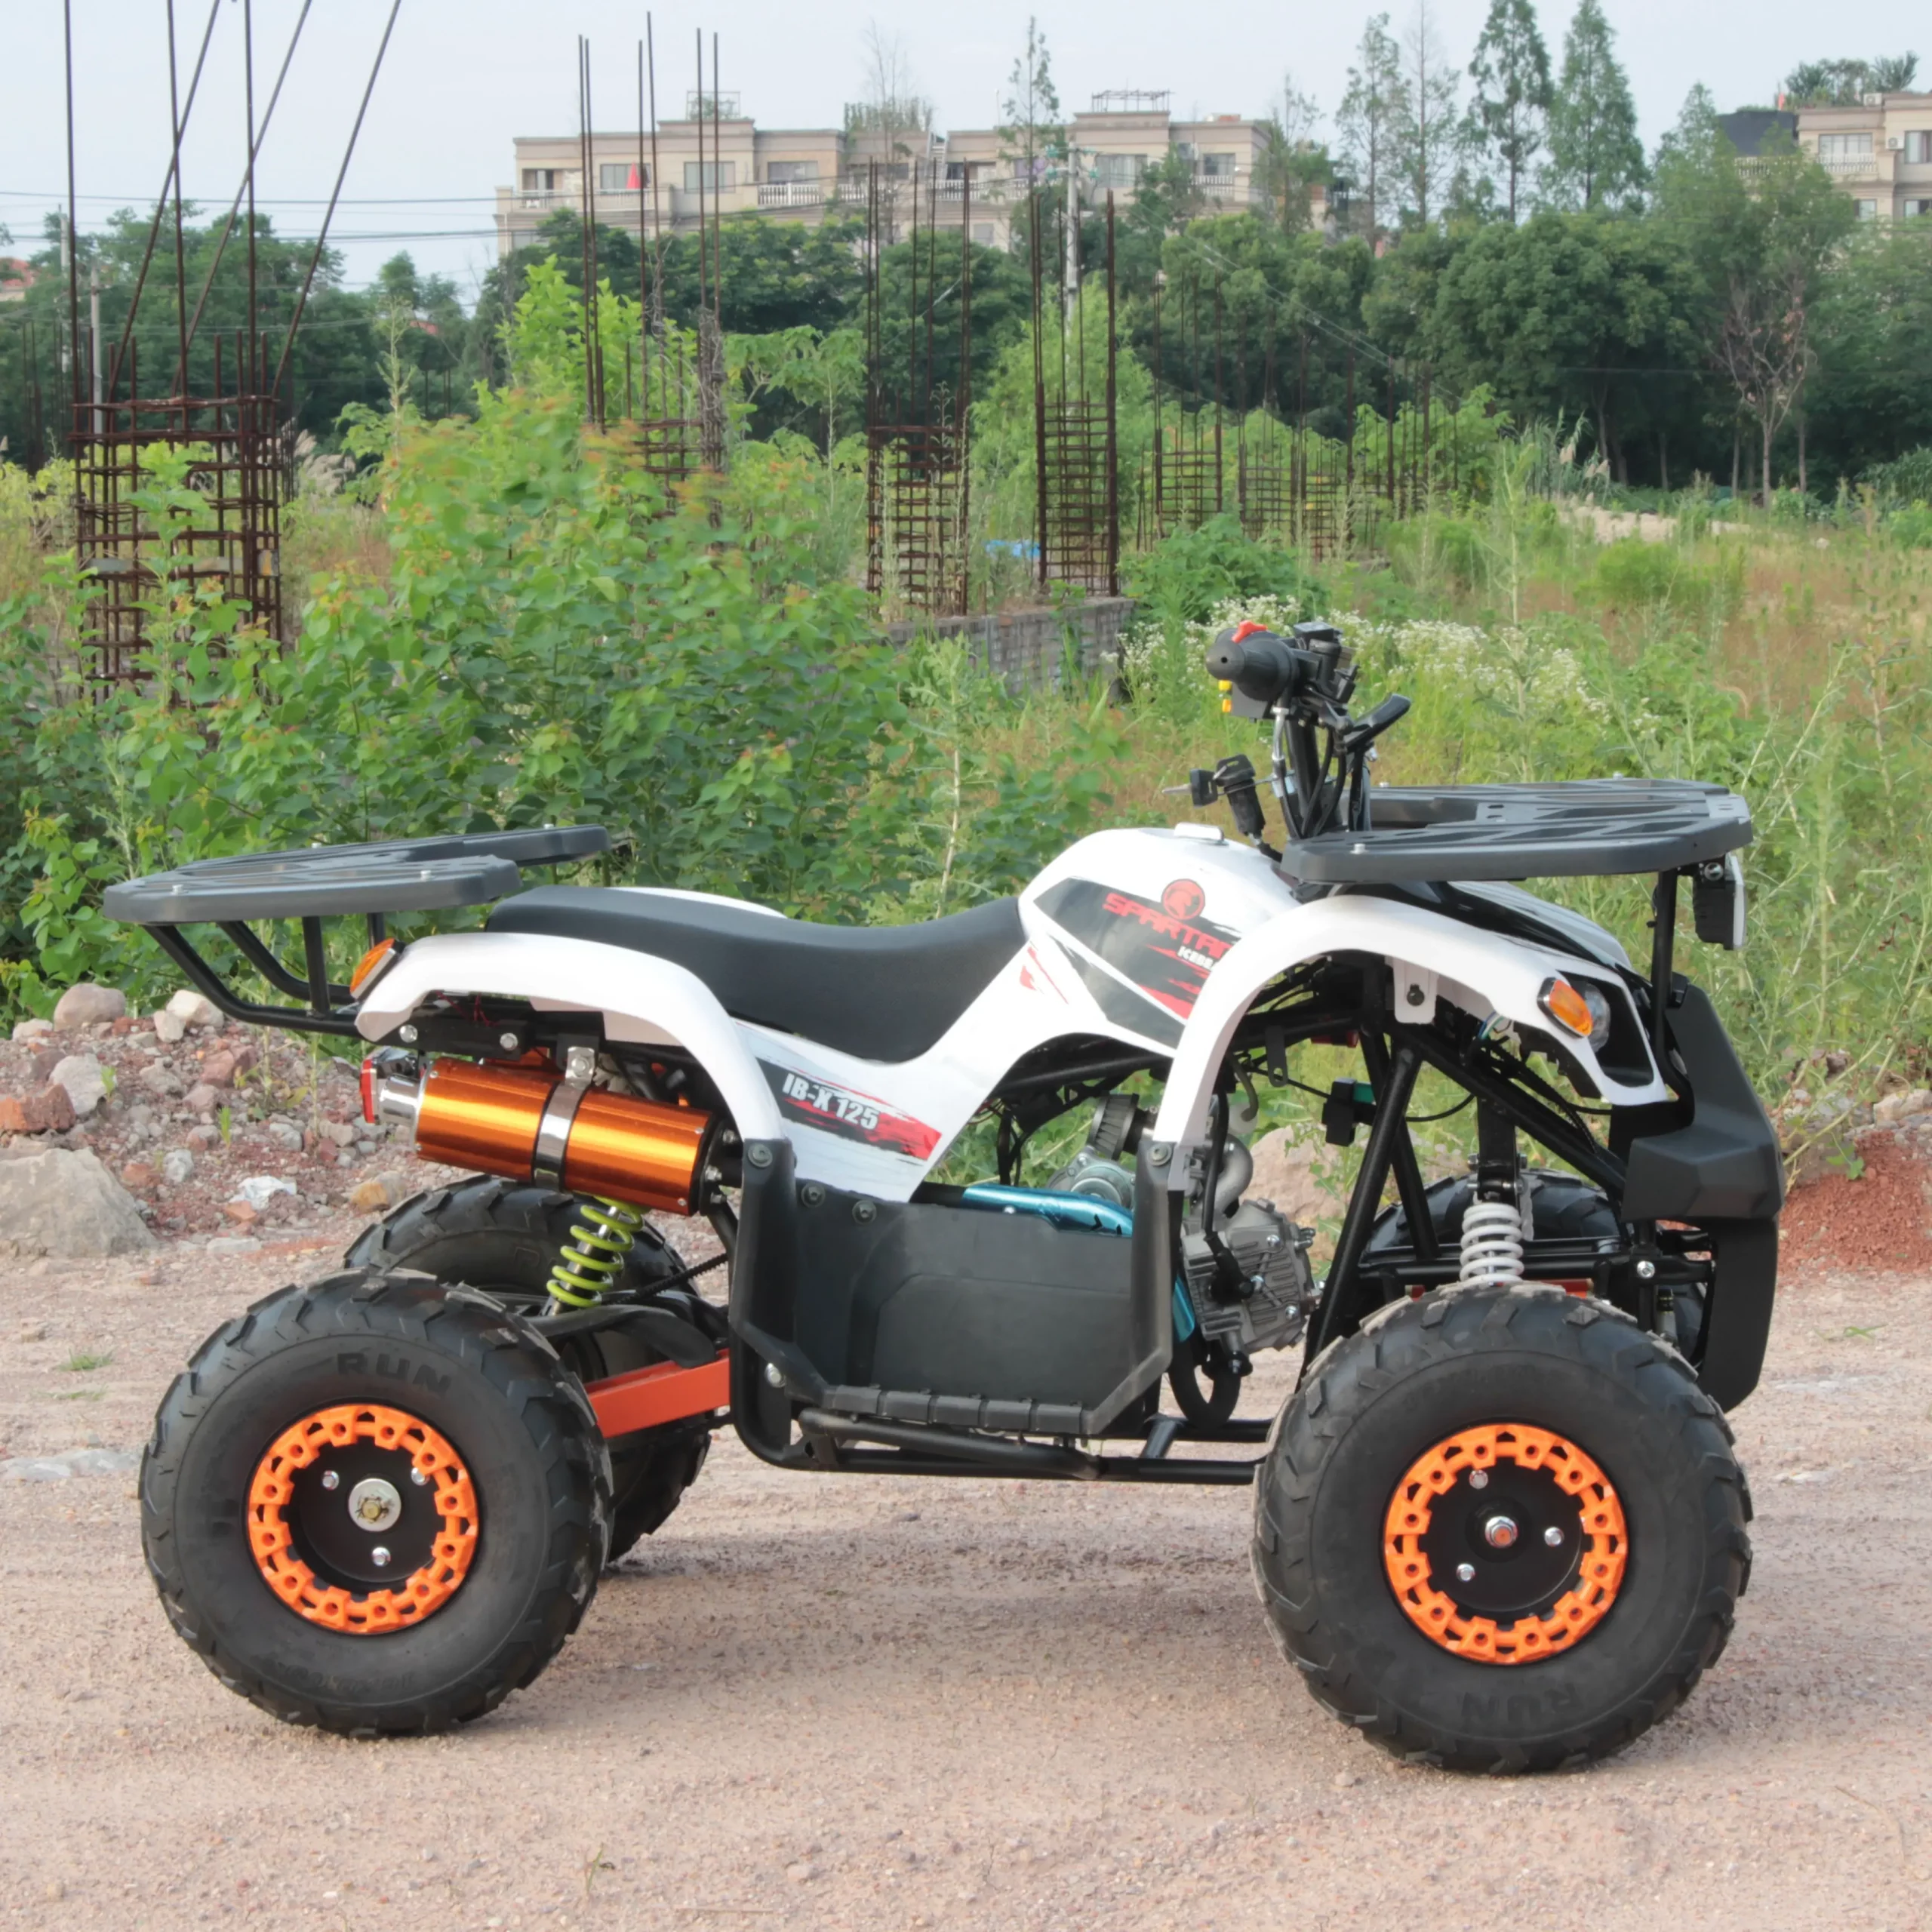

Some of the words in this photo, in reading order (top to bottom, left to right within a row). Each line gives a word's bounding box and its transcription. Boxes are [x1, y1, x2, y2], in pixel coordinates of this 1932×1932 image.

[782, 1073, 834, 1112] IB-X
[836, 1097, 881, 1131] 125
[337, 1352, 451, 1395] RUN
